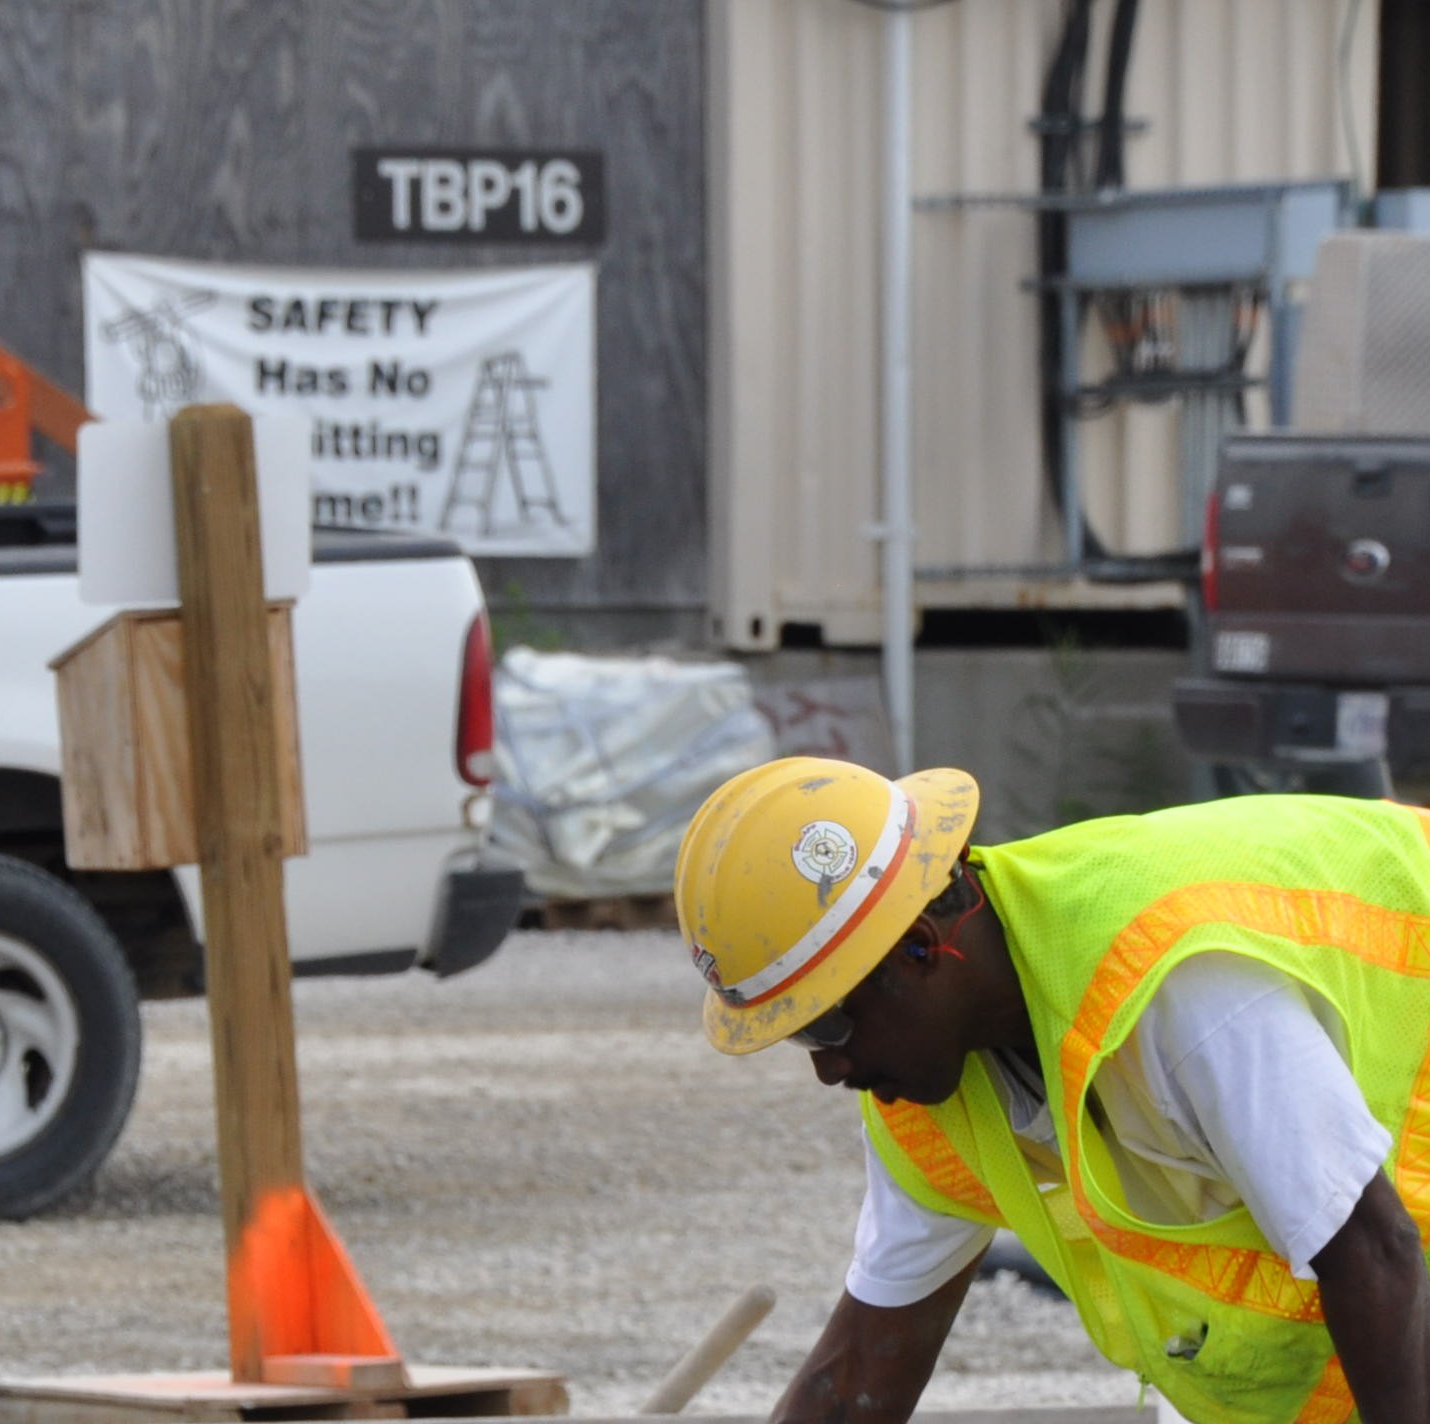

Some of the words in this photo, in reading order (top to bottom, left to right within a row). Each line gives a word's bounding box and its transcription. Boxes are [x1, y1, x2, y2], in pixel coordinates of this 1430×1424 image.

[376, 157, 585, 235] TBP16
[247, 296, 439, 336] SAFETY
[255, 358, 348, 397] Has
[369, 357, 432, 397] No
[313, 418, 442, 472] itting
[313, 484, 420, 523] me!!
